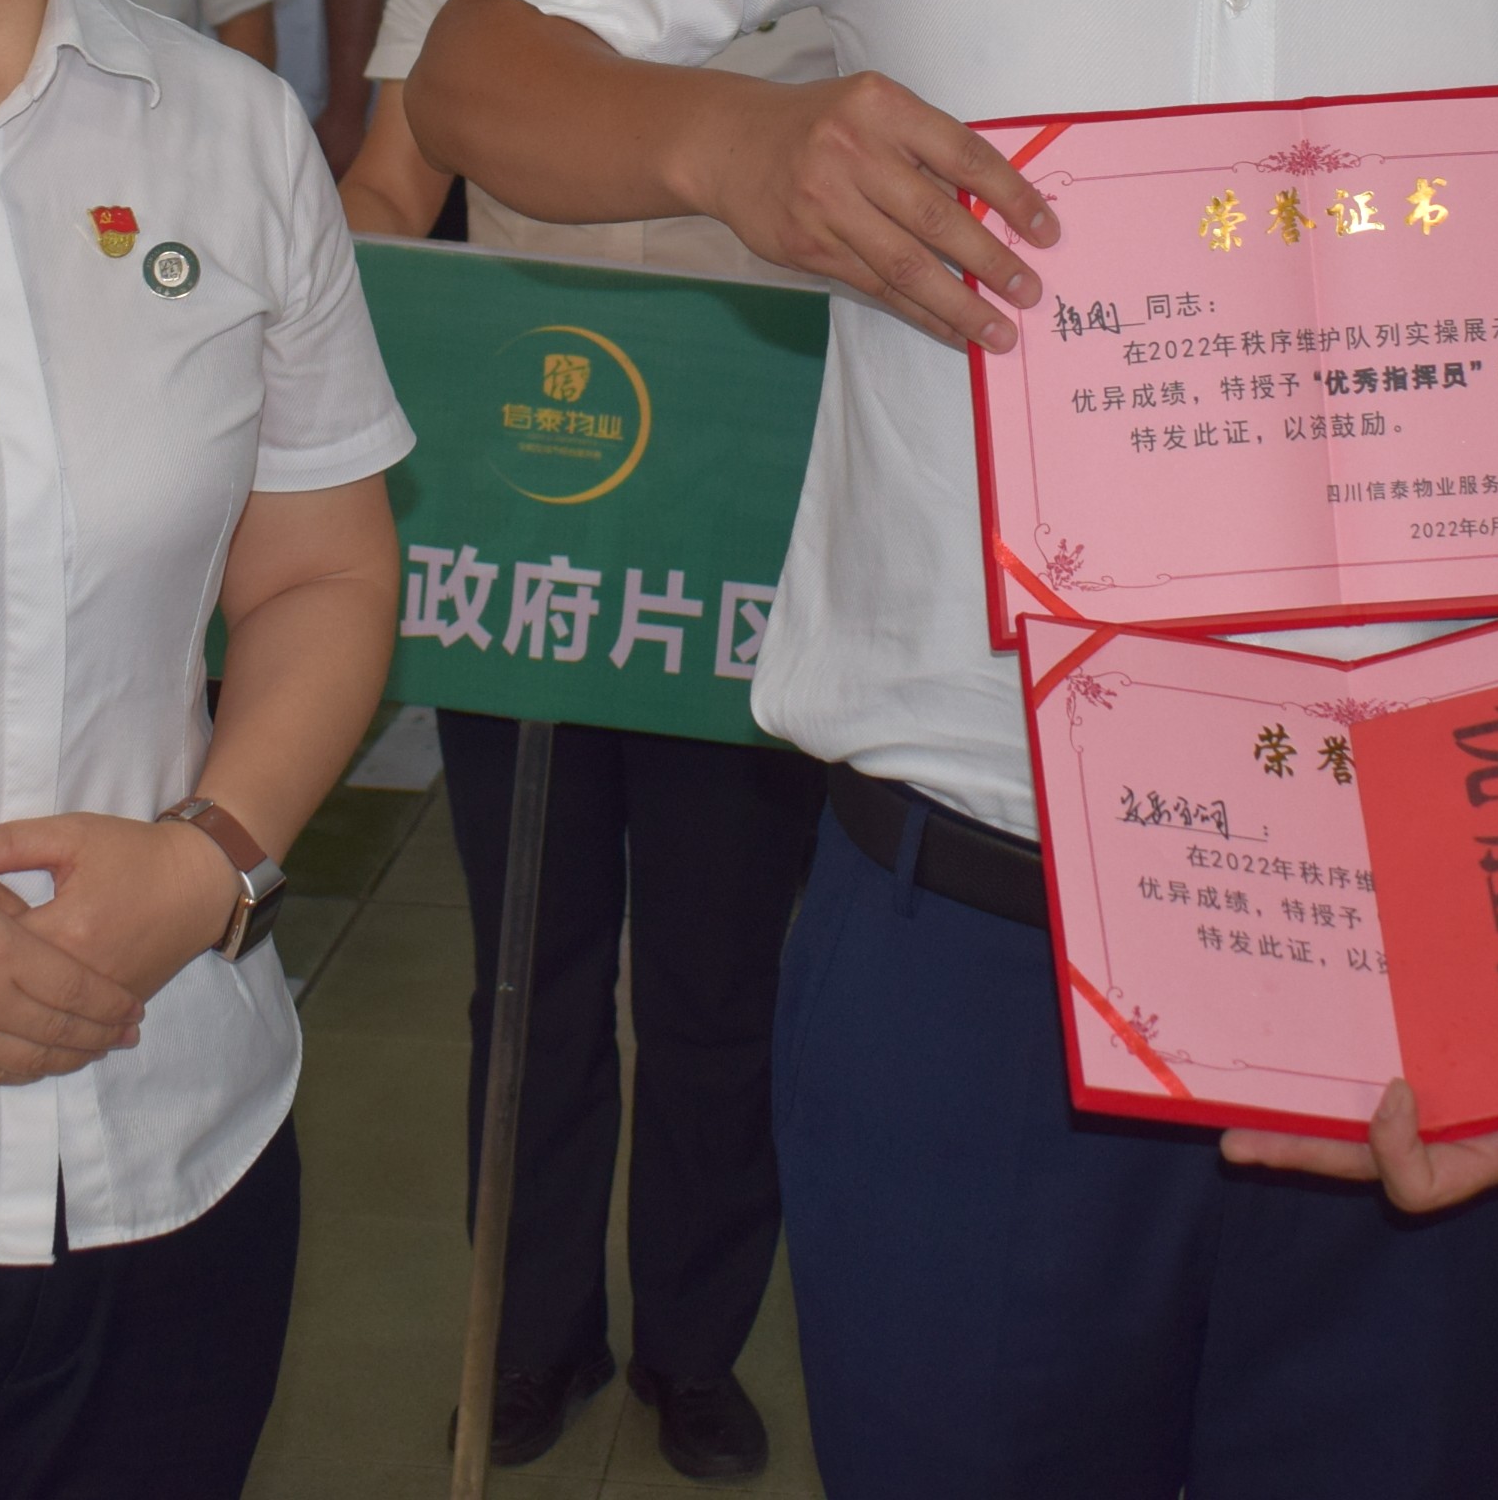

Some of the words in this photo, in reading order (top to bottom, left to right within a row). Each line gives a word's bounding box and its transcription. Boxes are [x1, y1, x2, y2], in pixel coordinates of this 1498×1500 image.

[1197, 177, 1451, 252] 荣誉证书
[502, 403, 624, 441] 信泰物业
[1131, 411, 1405, 454] 特发此证，以资鼓励。
[401, 544, 782, 681] 政府片区
[1253, 722, 1357, 786] 荣誉
[1138, 875, 1363, 930] 优异成绩，特授予
